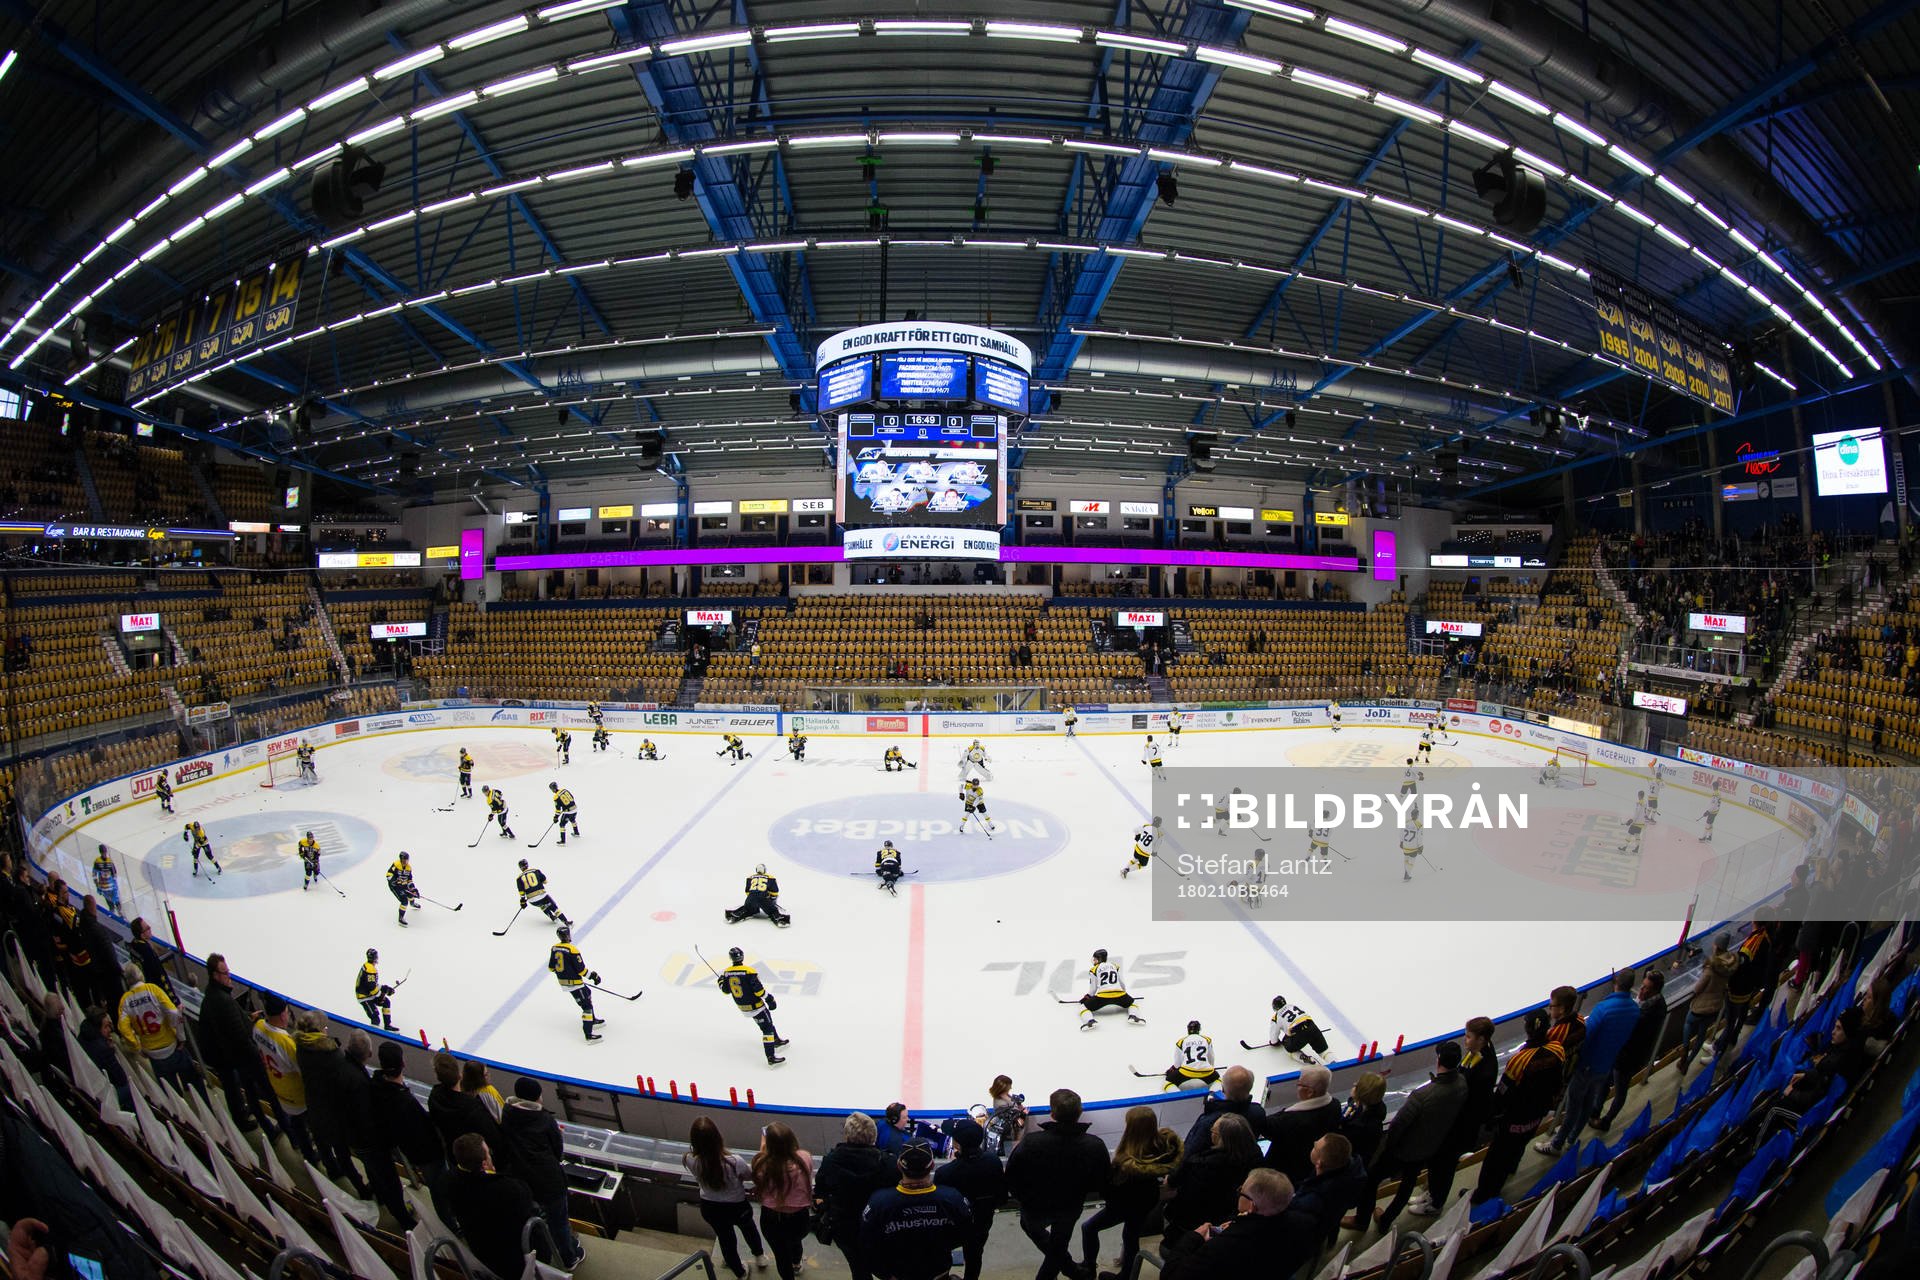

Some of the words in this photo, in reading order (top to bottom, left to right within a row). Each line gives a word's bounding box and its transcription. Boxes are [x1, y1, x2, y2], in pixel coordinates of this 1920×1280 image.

[843, 339, 853, 351] EN
[853, 334, 873, 348] GOD
[874, 330, 908, 344] KRAFT
[908, 328, 930, 342] FÖR
[932, 331, 952, 343] ETT
[953, 332, 979, 346] GOTT
[980, 337, 1019, 359] SAMHÄLLE
[1600, 330, 1630, 359] 1995
[1633, 345, 1659, 373] 2004
[1663, 360, 1687, 387] 2008
[1688, 375, 1710, 400] 2010
[1713, 388, 1732, 410] 2017
[889, 417, 896, 426] 0
[911, 416, 936, 424] 16:49
[950, 417, 957, 426] 0
[802, 501, 825, 509] SEB
[72, 527, 89, 537] BAR
[90, 528, 96, 536] &
[97, 528, 145, 538] RESTAURANG
[900, 539, 955, 550] ENERGI
[963, 539, 973, 550] EN
[973, 540, 986, 550] GOD
[1640, 694, 1677, 713] Scandic
[643, 713, 678, 726] LEBA
[1365, 708, 1392, 719] JoDi
[949, 721, 984, 729] Husqvarna
[266, 741, 283, 753] SEW
[283, 736, 299, 750] SEW
[1596, 747, 1637, 766] FAGERHULT
[1658, 763, 1677, 777] Kitron
[790, 818, 1050, 840] NordicBet
[1403, 829, 1417, 843] 27
[521, 872, 539, 889] 10
[750, 879, 768, 891] 25
[554, 951, 565, 973] 3
[1100, 971, 1118, 986] 20
[729, 977, 744, 999] 6
[1281, 1005, 1306, 1023] 31
[135, 1010, 161, 1037] 16
[1183, 1045, 1207, 1065] 12
